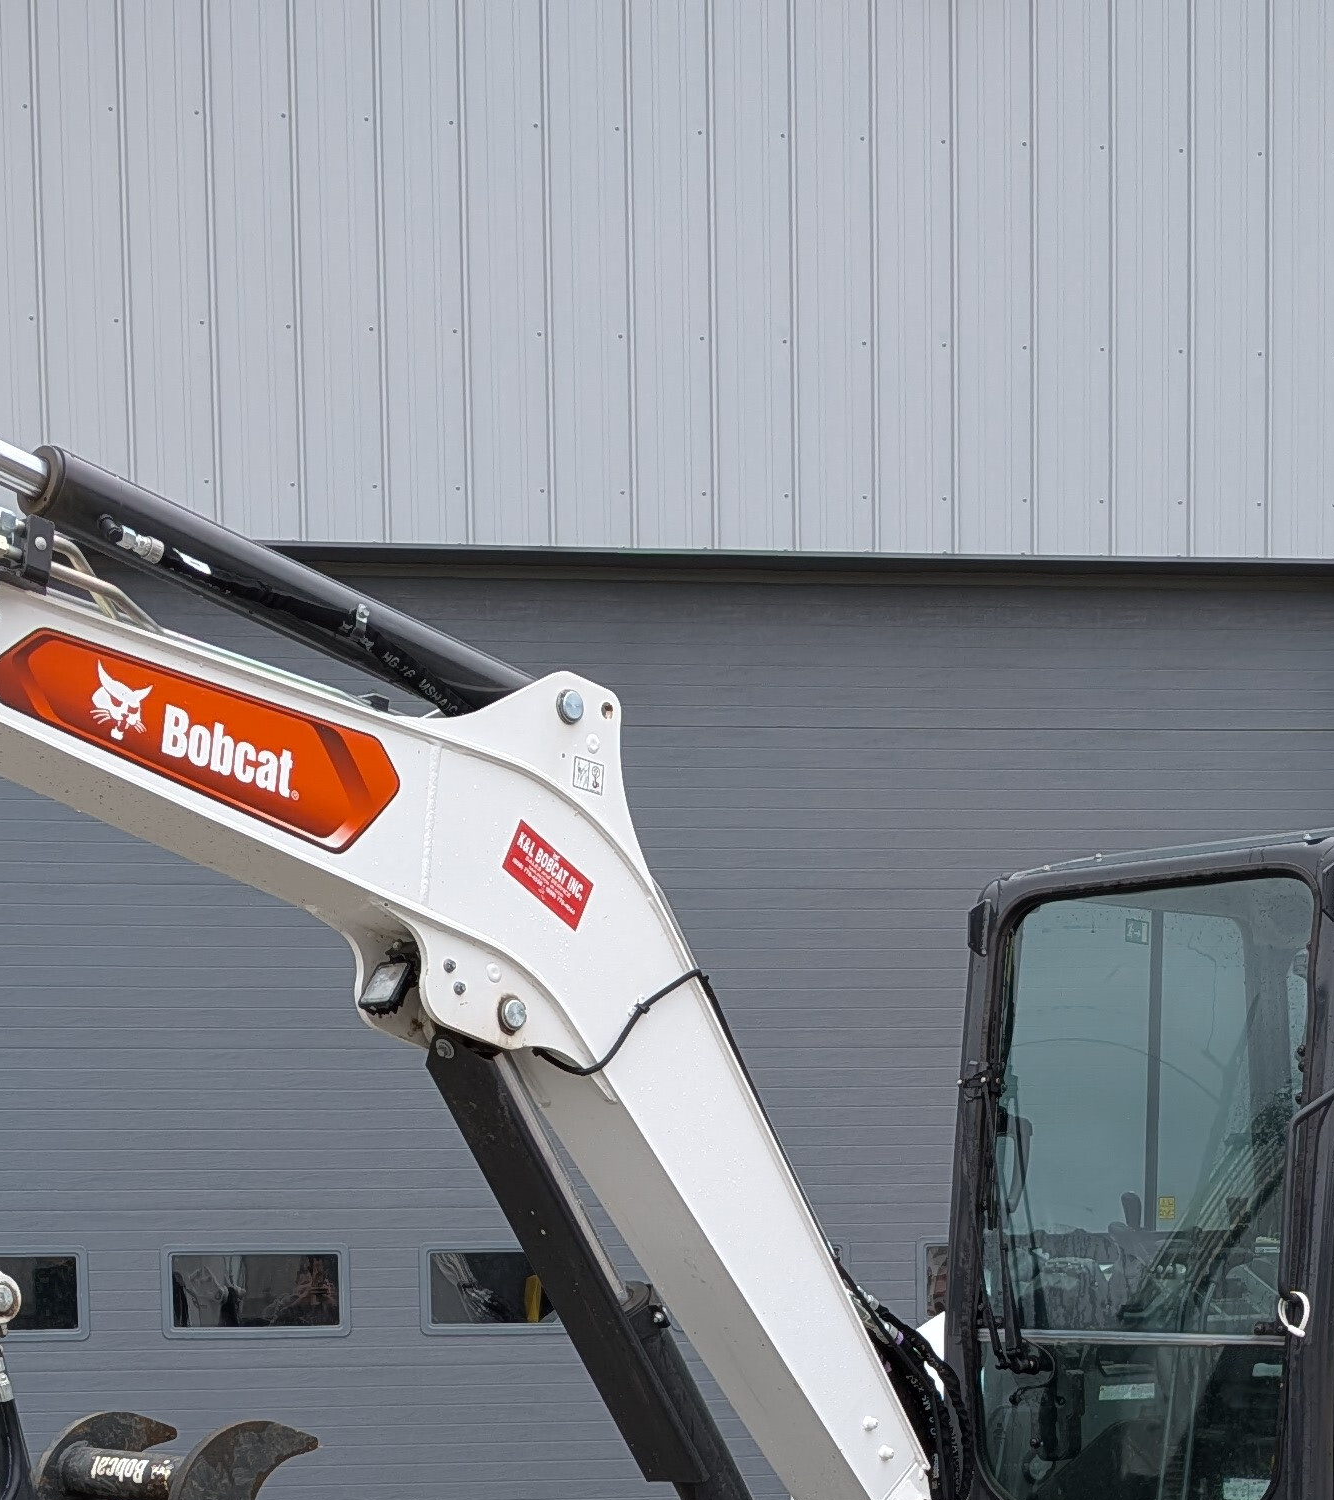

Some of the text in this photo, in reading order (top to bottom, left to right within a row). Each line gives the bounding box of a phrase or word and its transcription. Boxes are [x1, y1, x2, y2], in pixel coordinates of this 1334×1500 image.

[161, 703, 294, 798] Bobcat
[516, 831, 536, 858] K&L
[535, 848, 570, 886] BOBCAT
[566, 876, 584, 902] INC.
[90, 1455, 150, 1484] Bobcat
